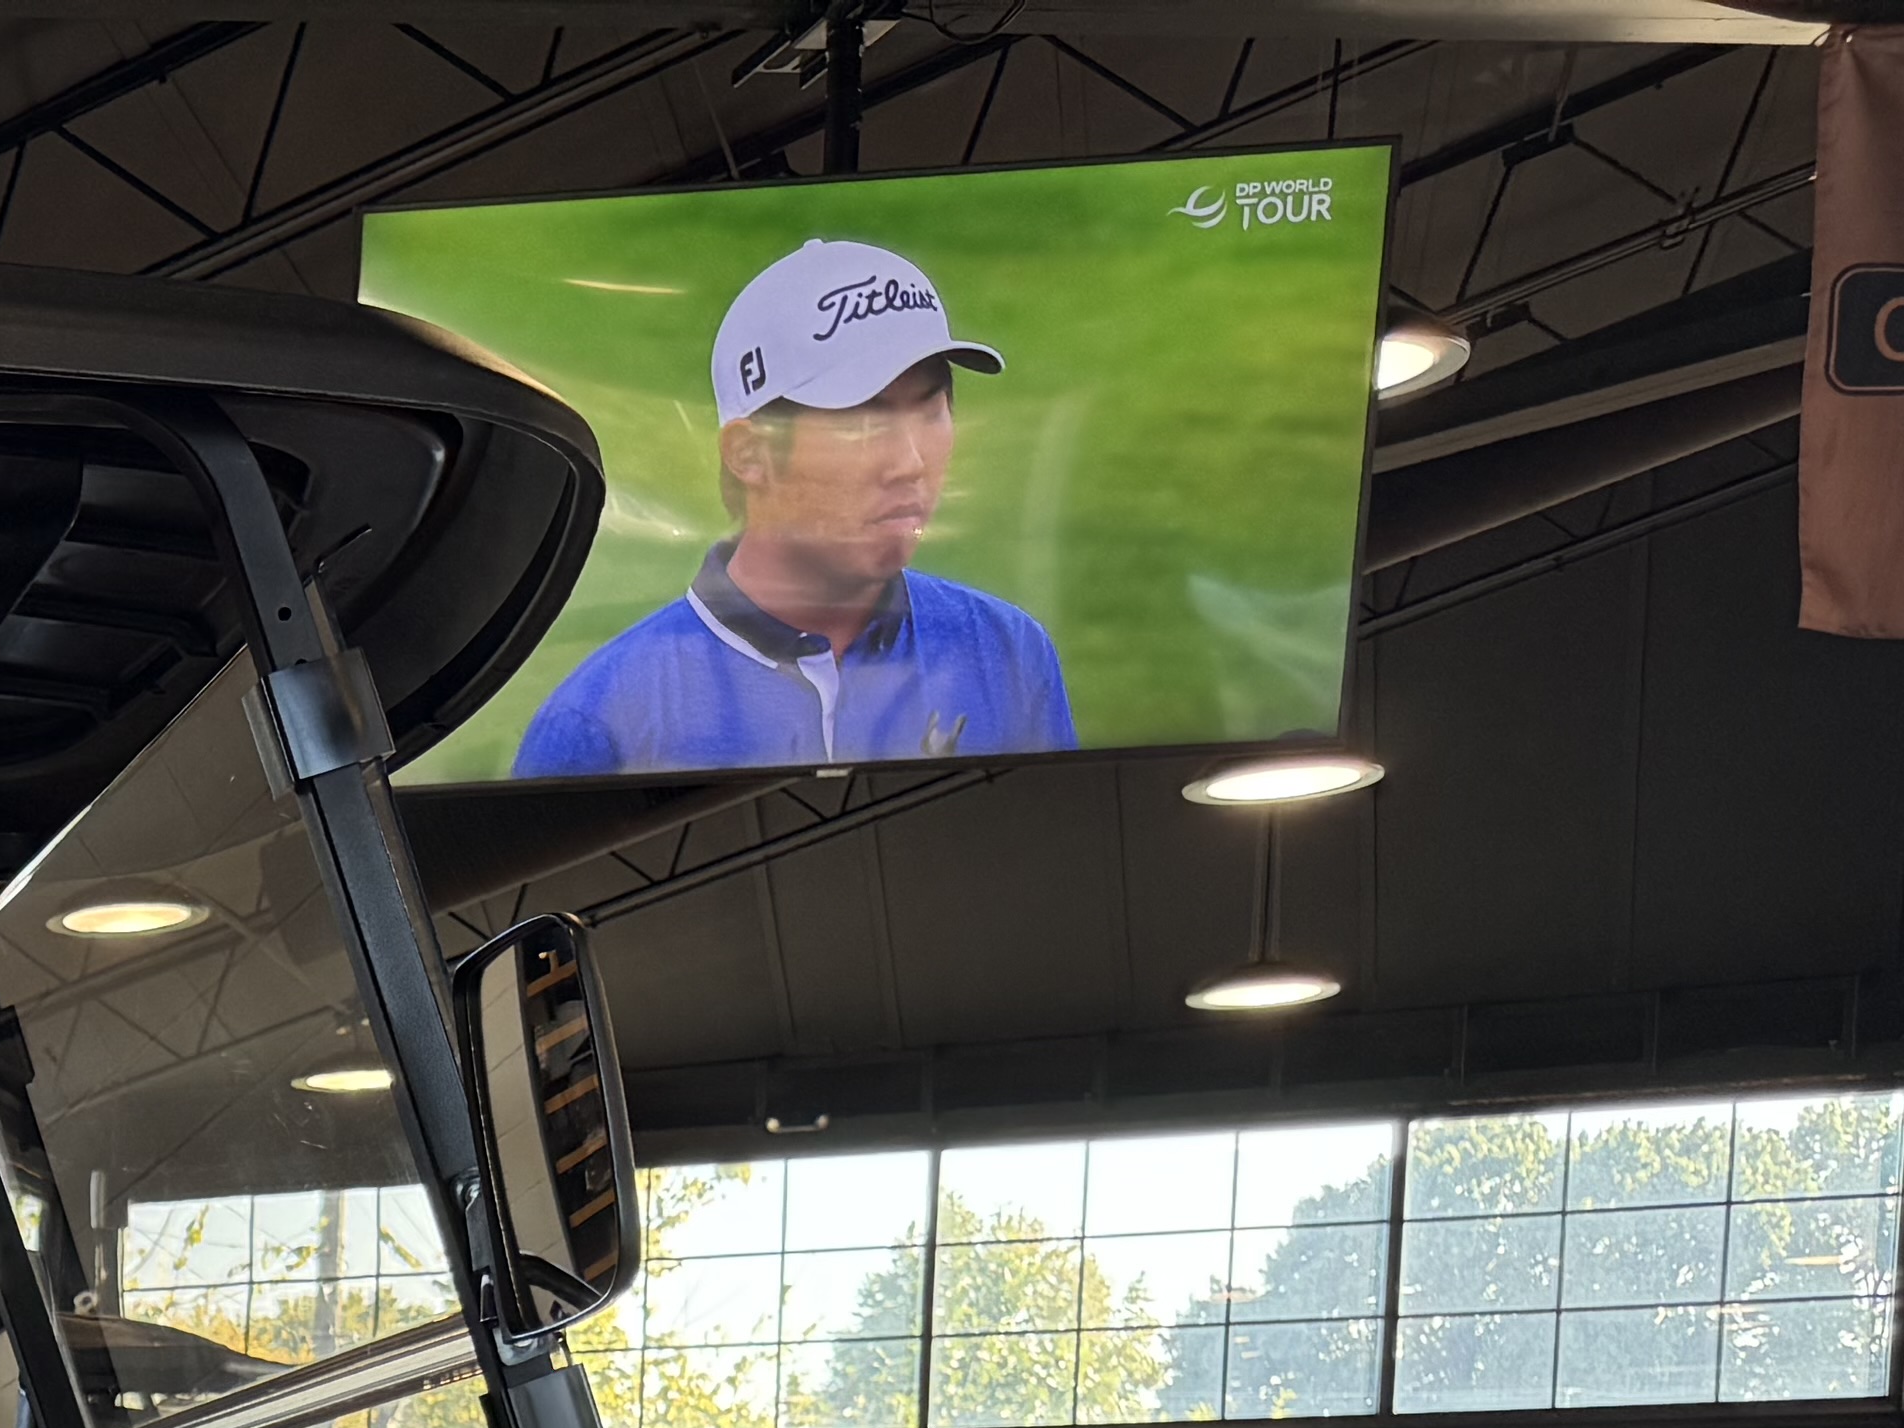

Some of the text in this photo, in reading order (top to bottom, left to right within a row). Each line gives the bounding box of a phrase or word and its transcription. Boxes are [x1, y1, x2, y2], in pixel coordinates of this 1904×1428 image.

[1236, 178, 1332, 196] DP WORLD
[1236, 193, 1332, 231] TOUR
[813, 275, 938, 341] Titleist
[740, 346, 767, 396] FJ
